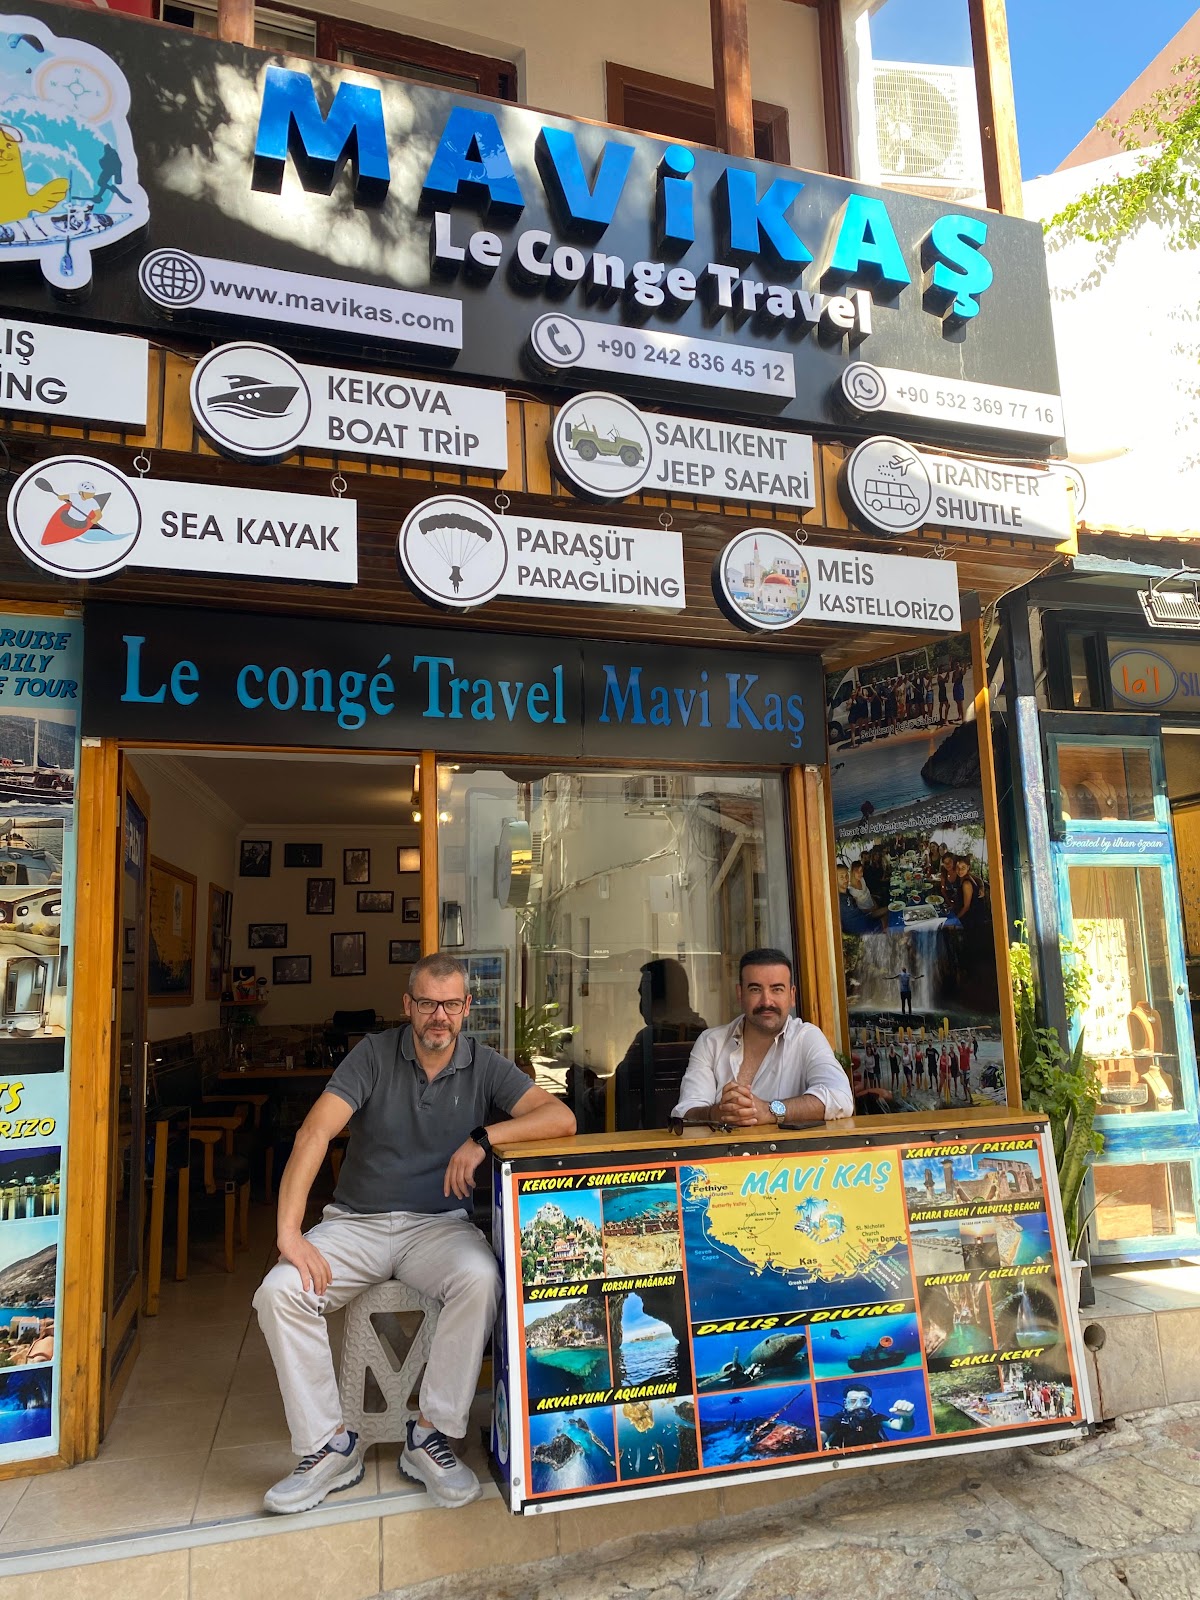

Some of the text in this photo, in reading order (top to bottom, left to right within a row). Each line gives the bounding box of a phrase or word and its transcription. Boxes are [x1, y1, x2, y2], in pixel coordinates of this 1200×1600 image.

[434, 211, 872, 335] Le Conge Travel
[210, 276, 455, 333] www.mavikas.com
[0, 328, 35, 366] IŞ
[597, 339, 785, 382] +90 242 836 45 12
[327, 375, 452, 416] KEKOVA
[896, 386, 1054, 423] +90 532 369 77 16
[327, 416, 480, 457] BOAT TRİP
[655, 421, 788, 461] SAKLIKENT
[657, 460, 810, 500] JEEP SAFARİ
[932, 462, 1040, 497] TRANSFER
[936, 497, 1023, 528] SHUTTLE
[160, 510, 340, 552] SEA KAYAK
[516, 527, 635, 566] PARAŞÜT
[517, 565, 680, 599] PARAGLİDİNG
[817, 556, 874, 586] MEİS
[819, 593, 954, 622] KASTELLORİZO
[14, 677, 78, 698] TOUR
[120, 635, 806, 749] Le congé Travel Mavi Kaş
[1060, 833, 1100, 848] Created
[1100, 837, 1112, 853] by
[906, 1139, 1034, 1159] XANTHOS / PATARA
[522, 1169, 667, 1192] KEKOVA / SUNKENCITY
[692, 1184, 728, 1193] Fethiye
[740, 1158, 892, 1197] MAVİ KAŞ
[911, 1201, 1041, 1221] PATARA BEACH / KAPUTAŞ BEACH
[880, 1235, 903, 1243] Demre
[529, 1274, 676, 1300] SIMENA KORSAN MAĞARASI
[924, 1264, 1051, 1287] KANYON / GİZLİ KENT
[697, 1303, 906, 1336] DALIŞ / DIVING
[950, 1348, 1045, 1369] SAKLI KENT
[615, 1382, 678, 1402] AQUARIUM
